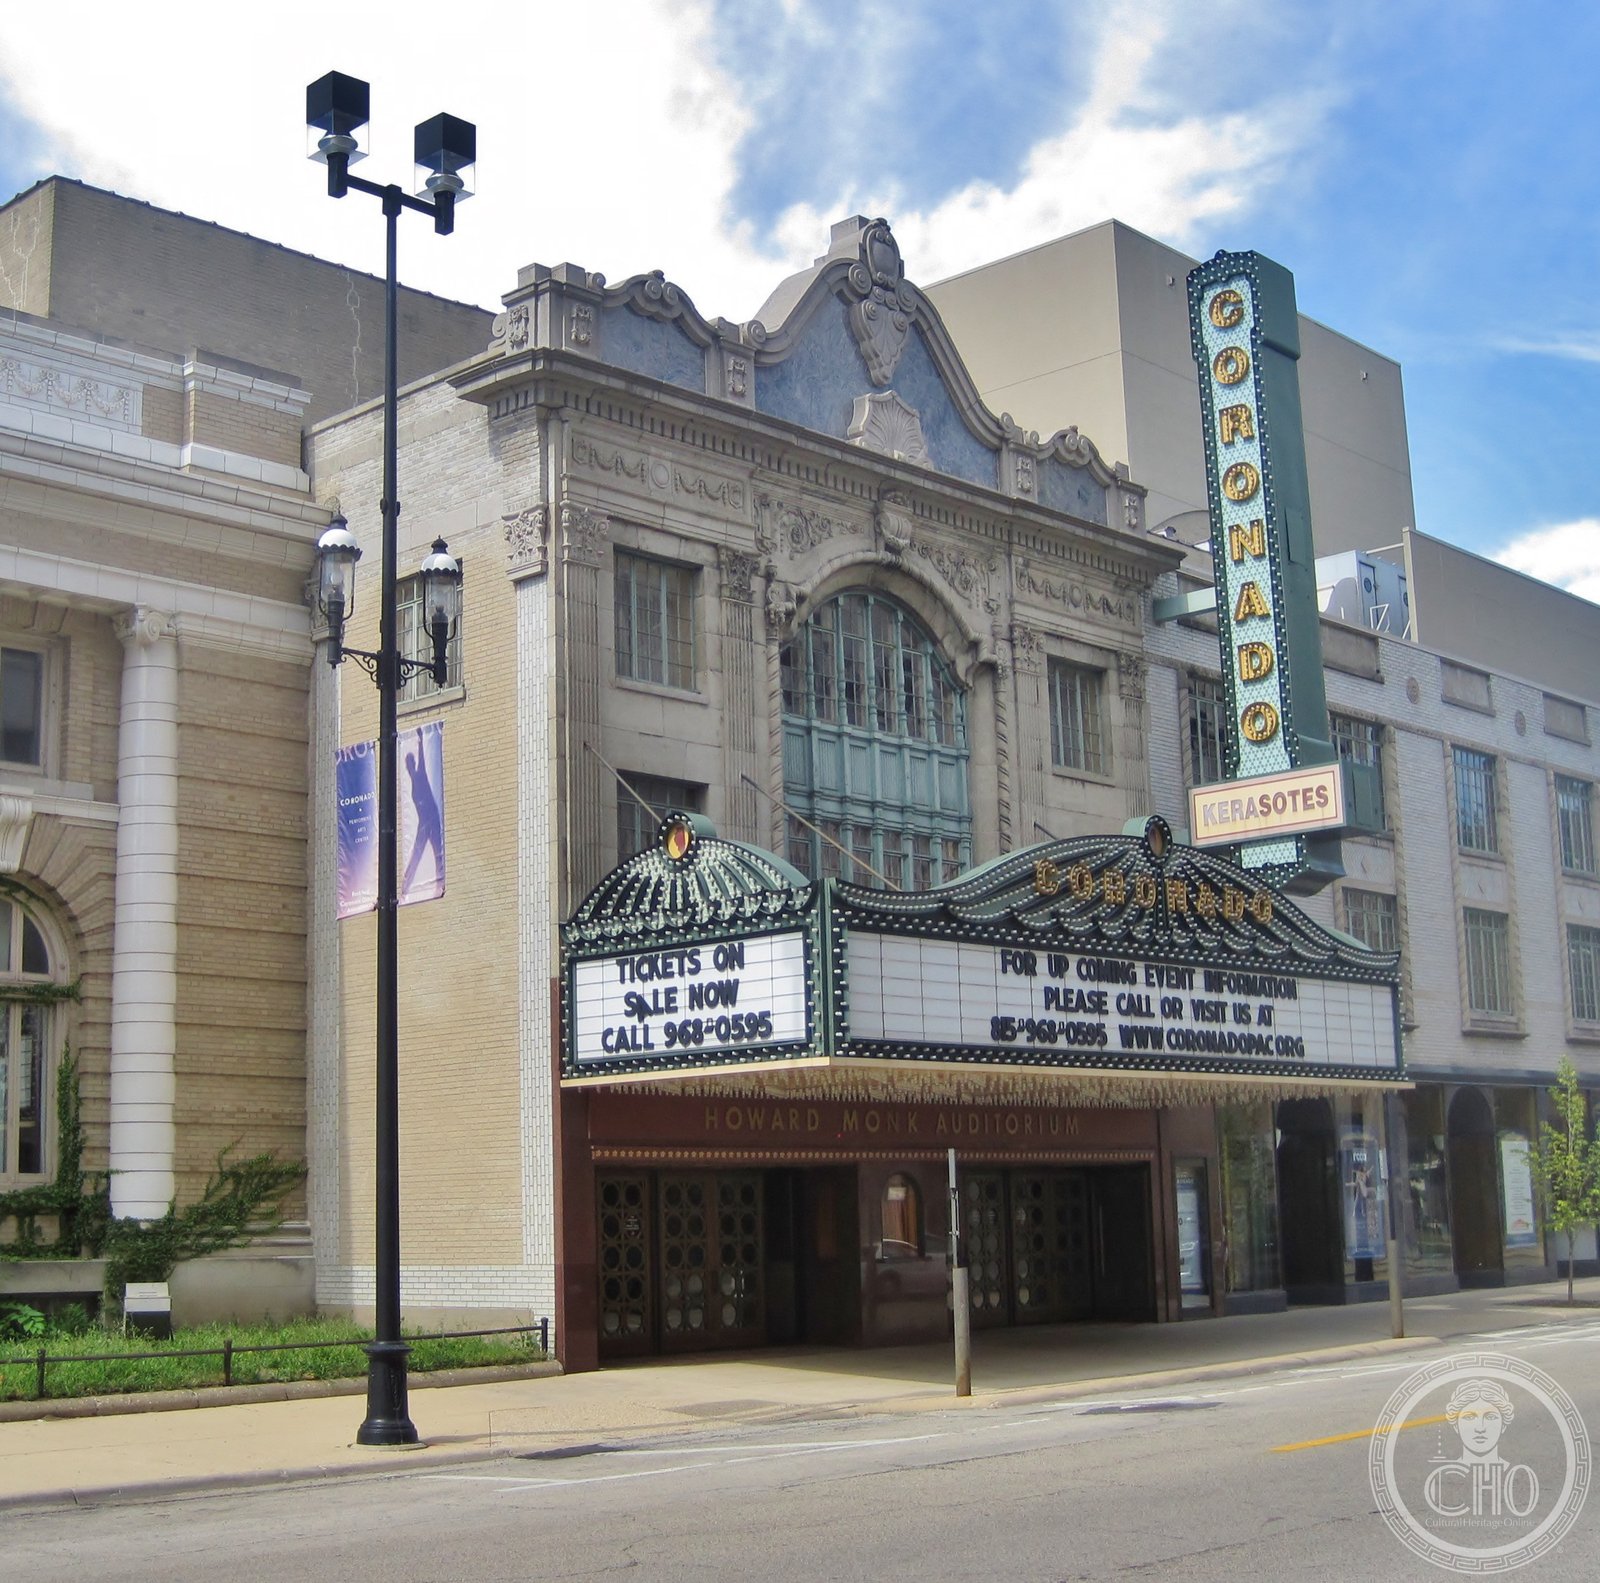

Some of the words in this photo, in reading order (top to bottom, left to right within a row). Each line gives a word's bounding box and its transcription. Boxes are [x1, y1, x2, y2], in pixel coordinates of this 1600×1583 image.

[1209, 289, 1278, 744] CORONADO
[340, 791, 375, 806] CORONADO
[1203, 785, 1328, 826] KERASOTES
[1035, 858, 1272, 924] CORONADO
[616, 948, 701, 984] TICKETS
[713, 942, 745, 972] ON
[1001, 949, 1037, 976] FOR
[1047, 953, 1069, 979] UP
[1076, 957, 1137, 985] COMING
[1144, 963, 1195, 990] EVENT
[1204, 970, 1297, 1000] INFORMATION
[624, 986, 678, 1022] SALE
[688, 979, 739, 1011] NOW
[1044, 986, 1108, 1015] PLEASE
[1116, 993, 1155, 1018] CALL
[1160, 996, 1183, 1020] OR
[1190, 999, 1227, 1023] VISIT
[1232, 1002, 1252, 1025] US
[1257, 1004, 1274, 1026] AT
[601, 1024, 654, 1053] CALL
[664, 1010, 773, 1048] 968-0595
[705, 1106, 820, 1131] HOWARD
[843, 1109, 918, 1133] MONK
[936, 1111, 1080, 1135] AUDITORIUM
